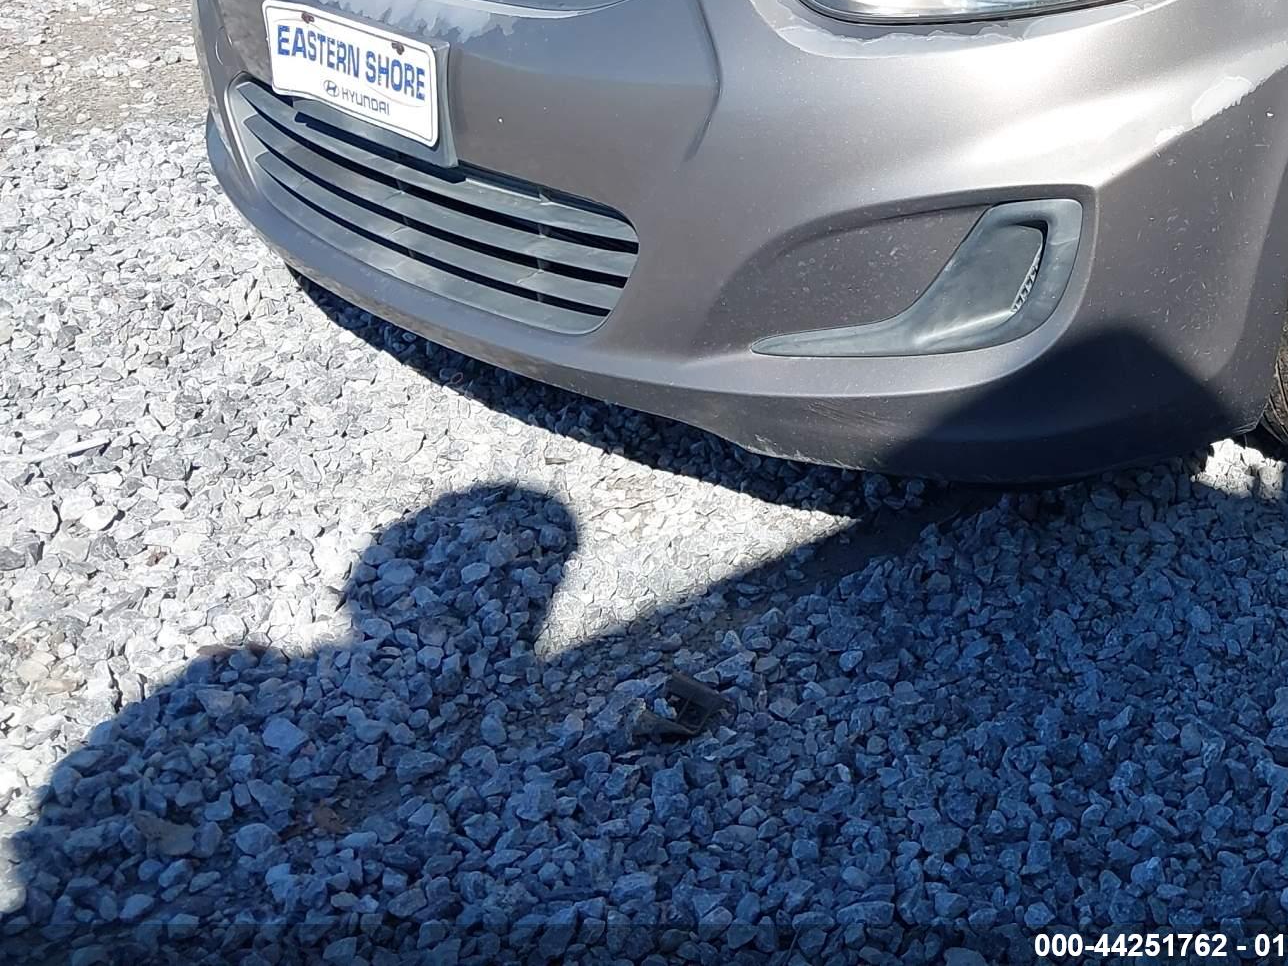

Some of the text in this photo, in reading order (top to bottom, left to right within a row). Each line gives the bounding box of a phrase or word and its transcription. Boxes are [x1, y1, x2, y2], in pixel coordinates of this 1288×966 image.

[277, 25, 426, 101] EASTERN SHORE
[342, 86, 391, 116] HYUNDAI
